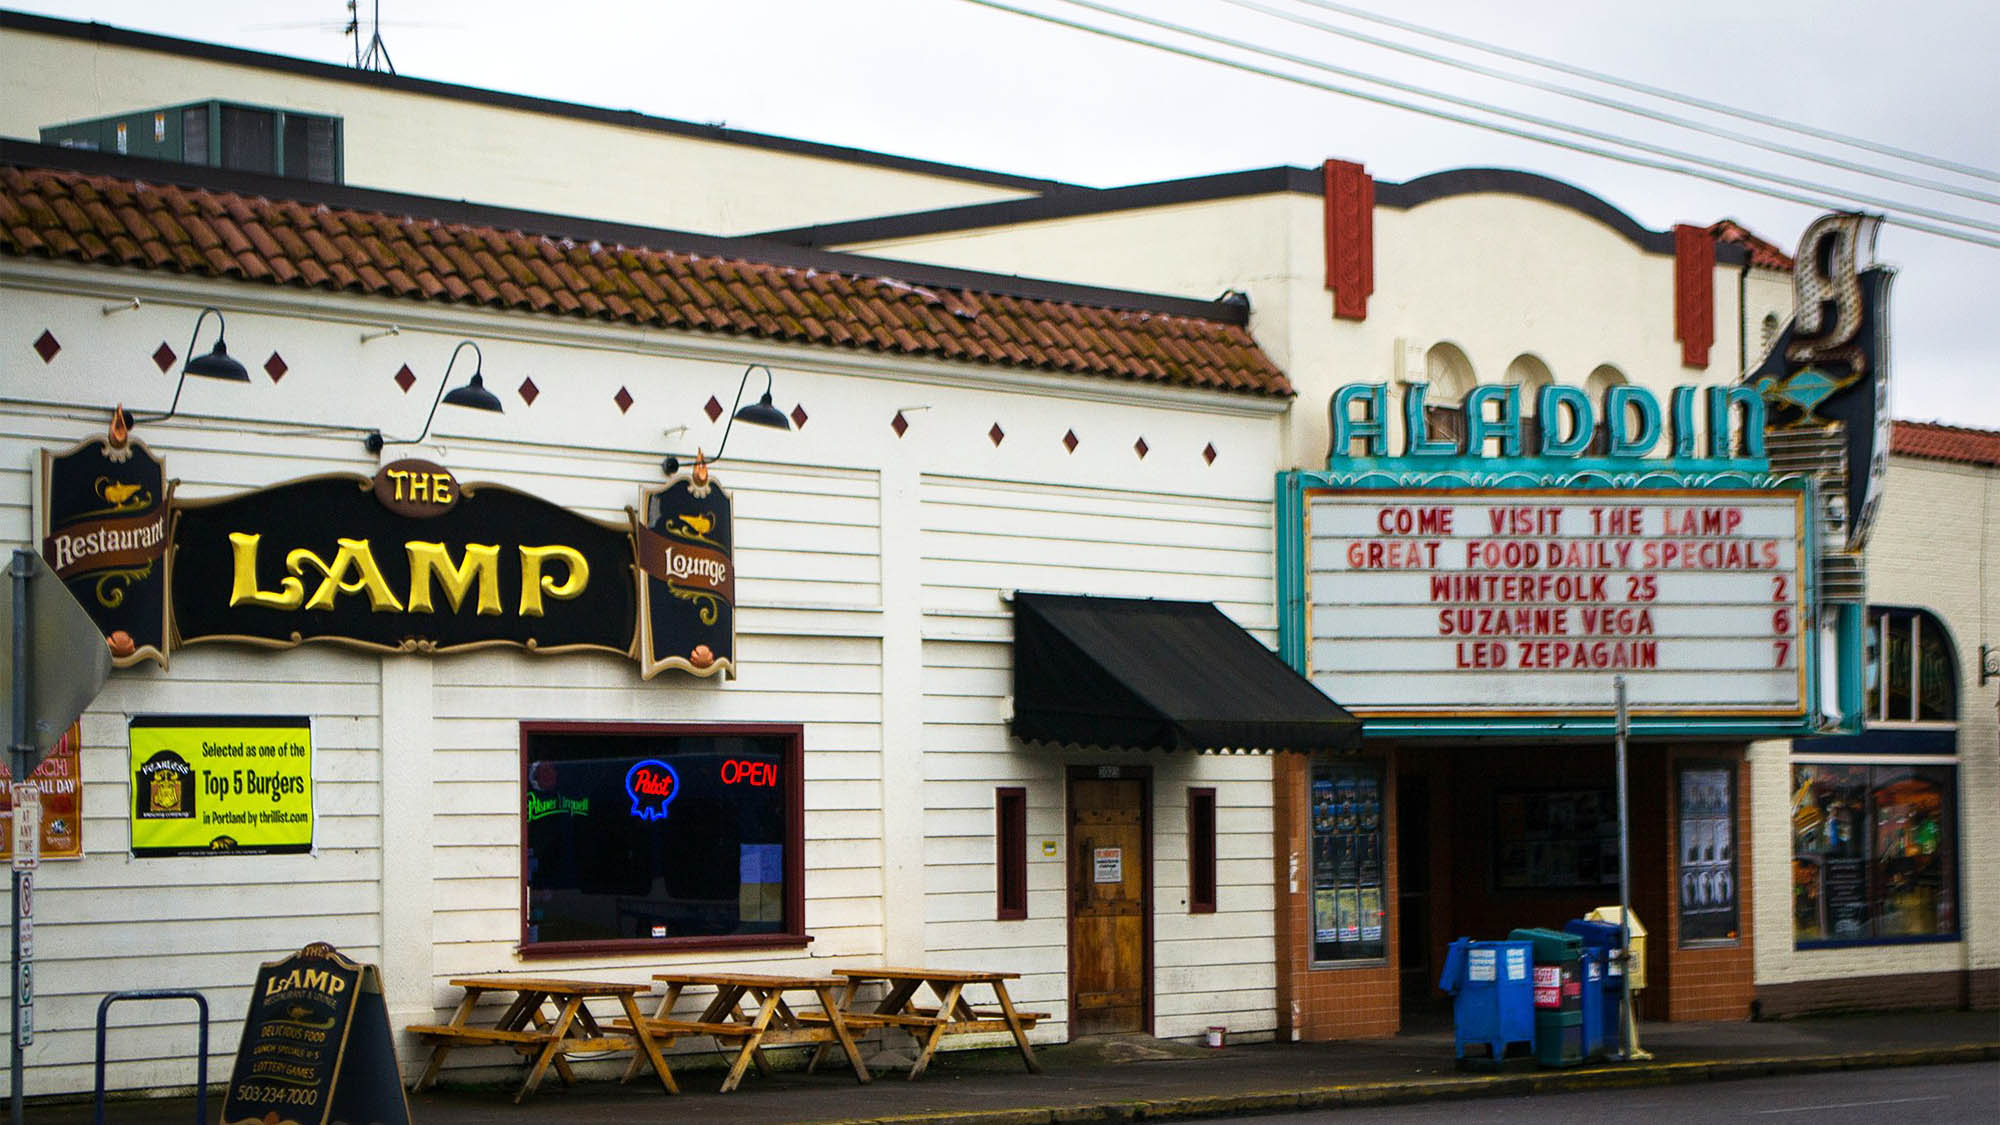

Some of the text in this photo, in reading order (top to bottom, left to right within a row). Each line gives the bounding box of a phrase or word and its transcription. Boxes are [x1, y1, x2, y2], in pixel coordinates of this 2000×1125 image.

[1331, 381, 1768, 459] ALADDIN
[387, 468, 453, 504] THE
[1377, 507, 1742, 536] COME VISIT THE LAMP
[54, 517, 164, 571] Restaurant
[1346, 540, 1779, 569] GREAT FOOD DAILY SPECIALS
[228, 531, 590, 617] LAMP
[665, 546, 726, 587] Lounge
[1429, 573, 1788, 603] WINTERFOLK 25 2
[1438, 606, 1789, 636] SUZANNE VEGA 6
[1456, 640, 1789, 670] LED ZEPAGAIN 7
[202, 742, 305, 758] Selected as one of the
[56, 779, 75, 794] DAY
[203, 769, 305, 803] Top 5 Burgers
[634, 769, 673, 796] Pabst
[720, 759, 777, 787] OPEN
[203, 811, 211, 824] in
[212, 810, 246, 824] Portland
[247, 812, 258, 827] by
[259, 810, 308, 824] thrillist.com
[265, 968, 345, 997] LAMP
[304, 1032, 326, 1042] FOOD
[253, 1061, 315, 1078] LOTTERY GAMES
